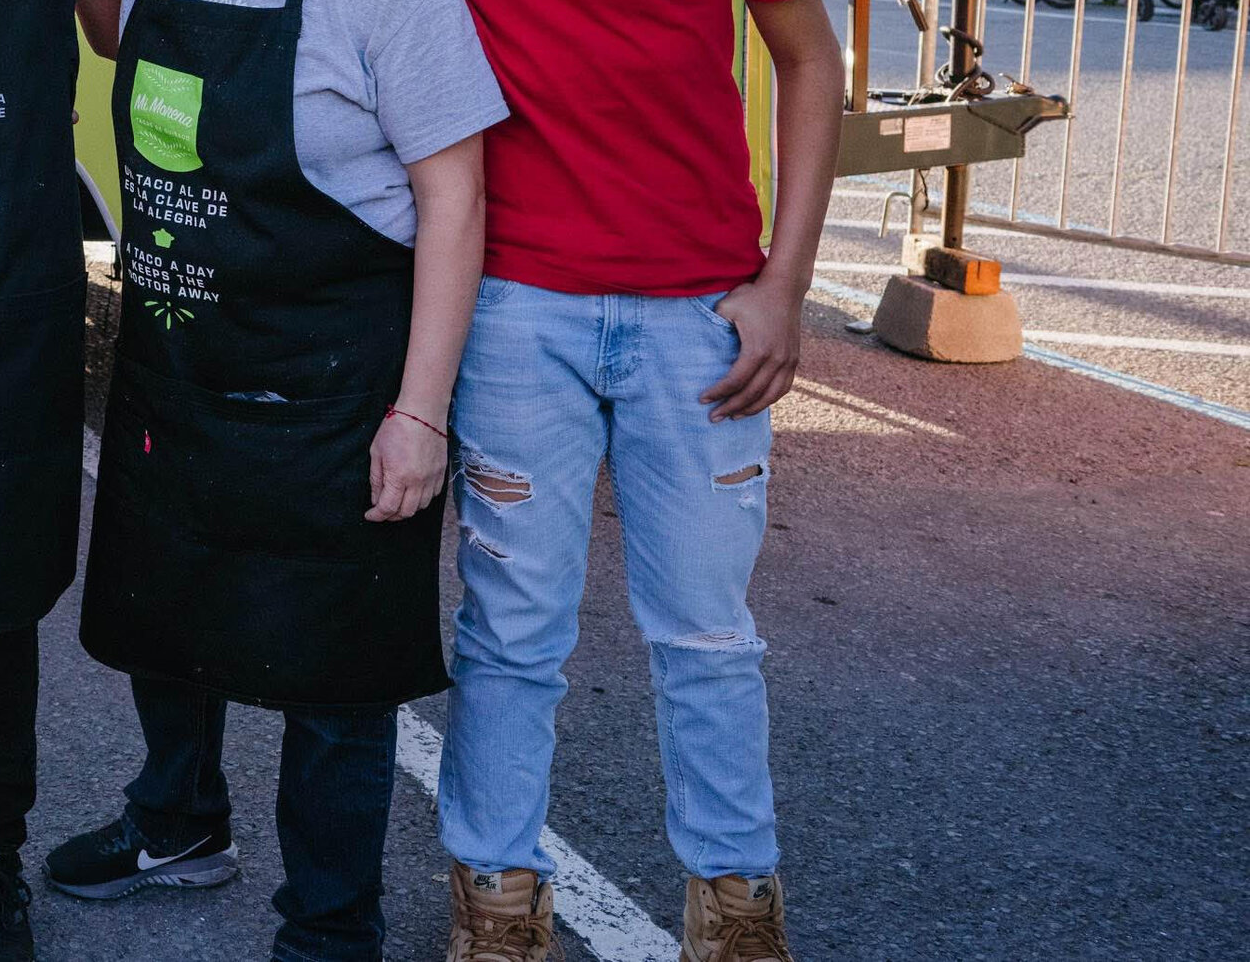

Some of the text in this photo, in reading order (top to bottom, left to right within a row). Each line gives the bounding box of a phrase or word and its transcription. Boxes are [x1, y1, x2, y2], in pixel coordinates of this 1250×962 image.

[134, 93, 193, 128] Mi Morena
[124, 179, 228, 217] ES LA CLAVE DE
[136, 173, 174, 192] TACO
[179, 184, 194, 198] AL
[202, 188, 229, 203] DIA
[133, 198, 207, 229] LA ALEGRIA
[126, 242, 215, 279] A TACO A DAY
[132, 259, 205, 289] KEEPS THE
[178, 286, 220, 303] AWAY
